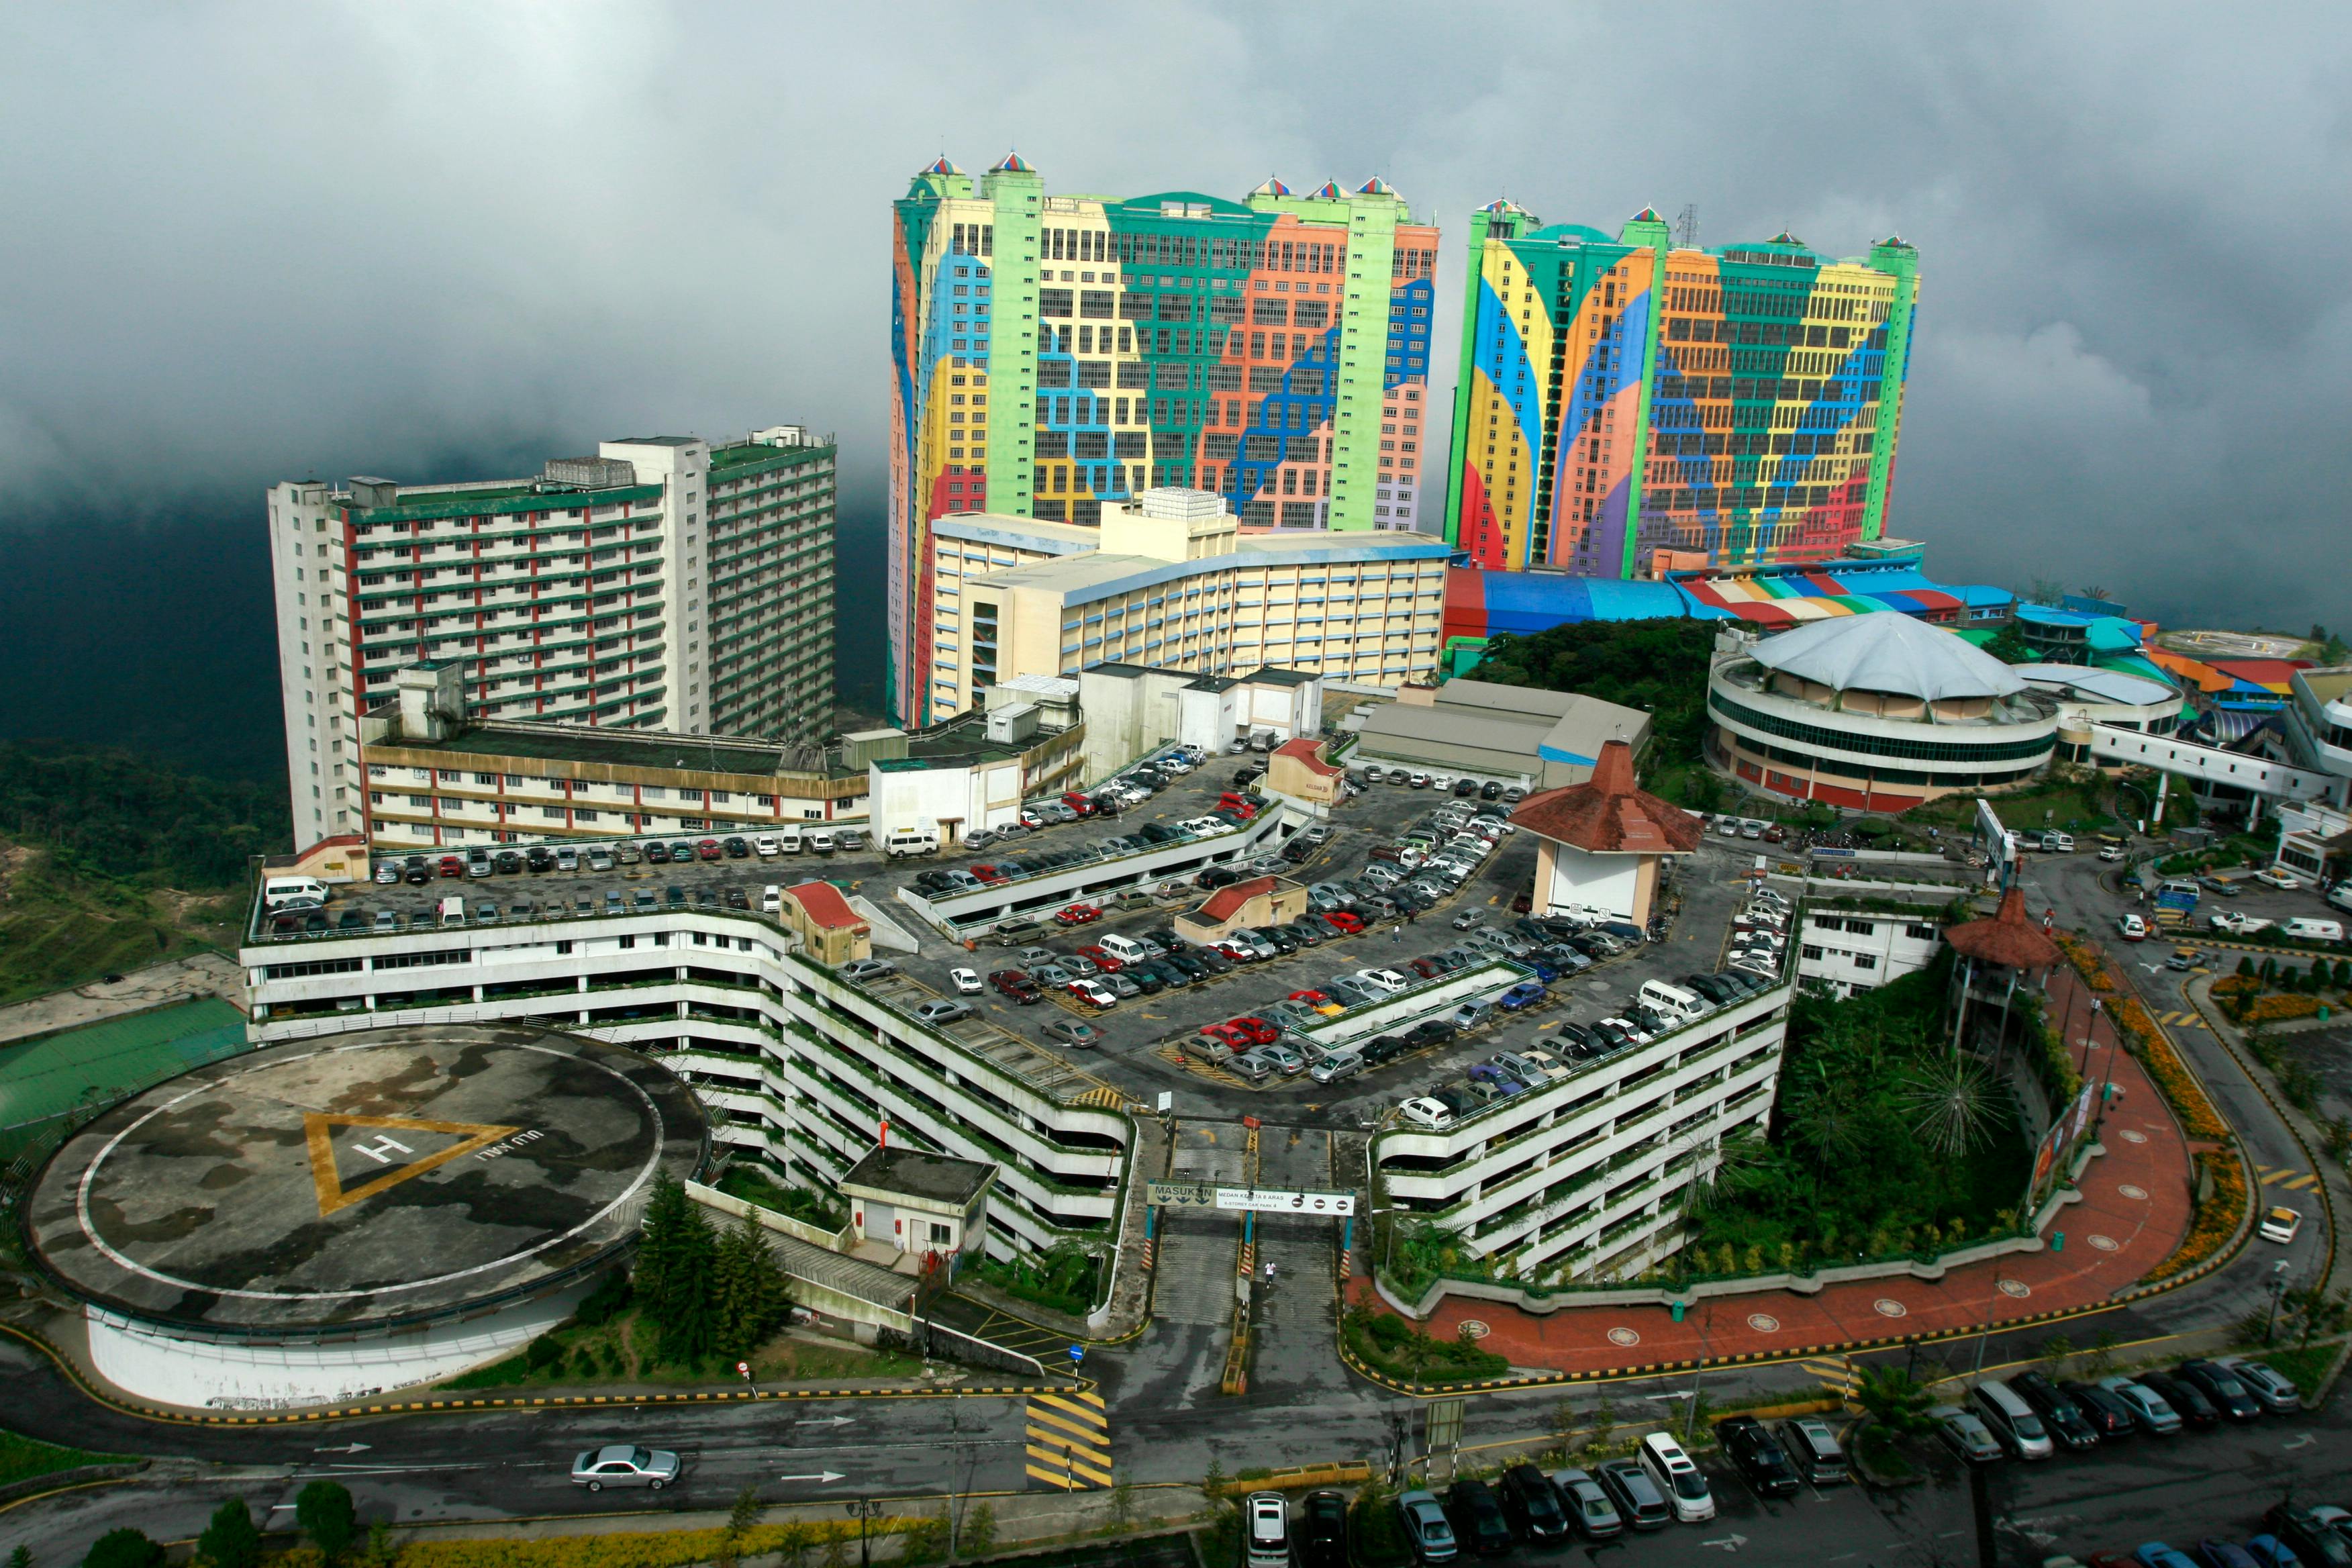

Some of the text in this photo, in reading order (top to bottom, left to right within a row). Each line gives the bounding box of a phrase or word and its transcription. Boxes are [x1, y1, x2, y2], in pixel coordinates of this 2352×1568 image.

[351, 1134, 415, 1163] H
[474, 1130, 545, 1161] ULU KALI
